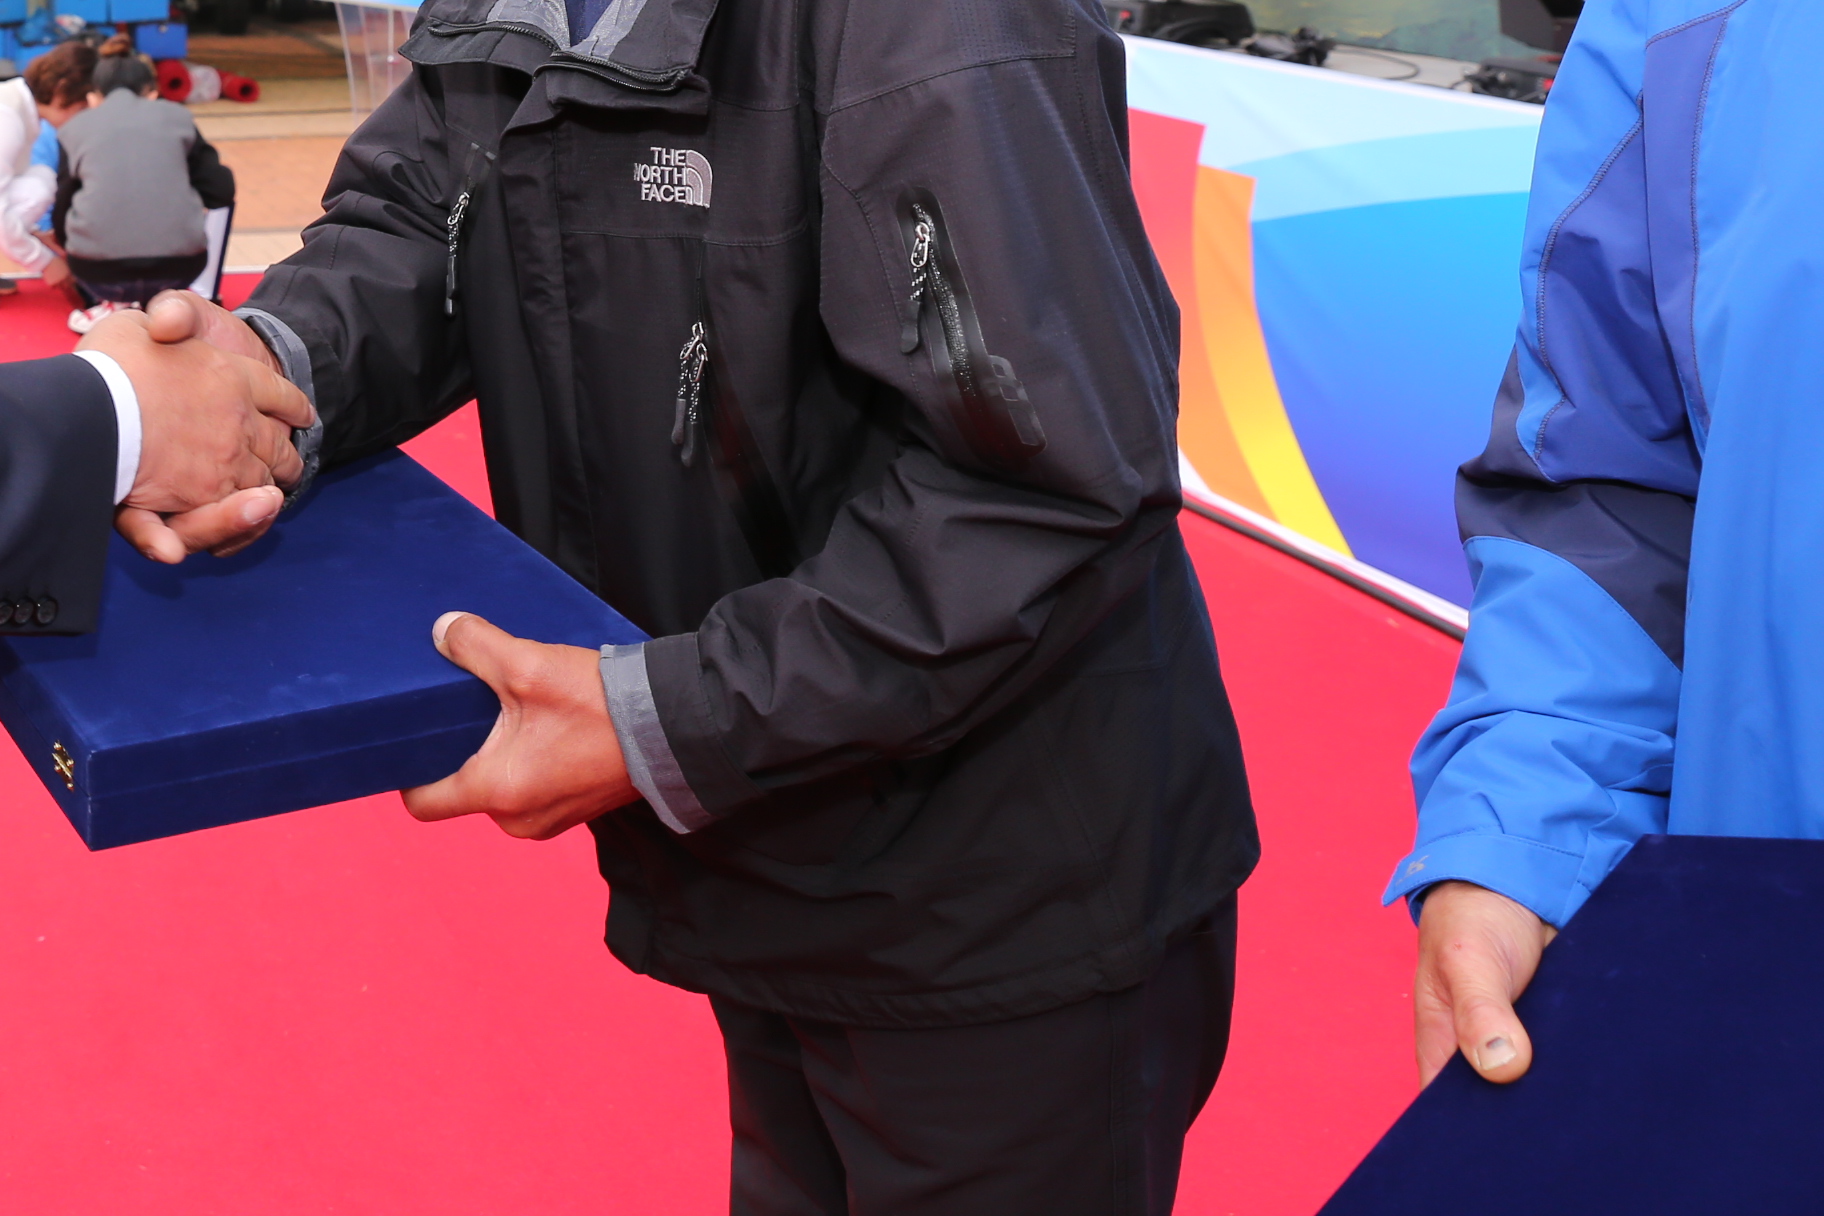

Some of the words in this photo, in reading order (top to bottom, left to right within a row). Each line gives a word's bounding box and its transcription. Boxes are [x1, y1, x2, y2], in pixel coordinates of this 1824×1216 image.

[650, 146, 686, 166] THE
[633, 162, 686, 185] NORTH
[641, 183, 686, 203] FACE
